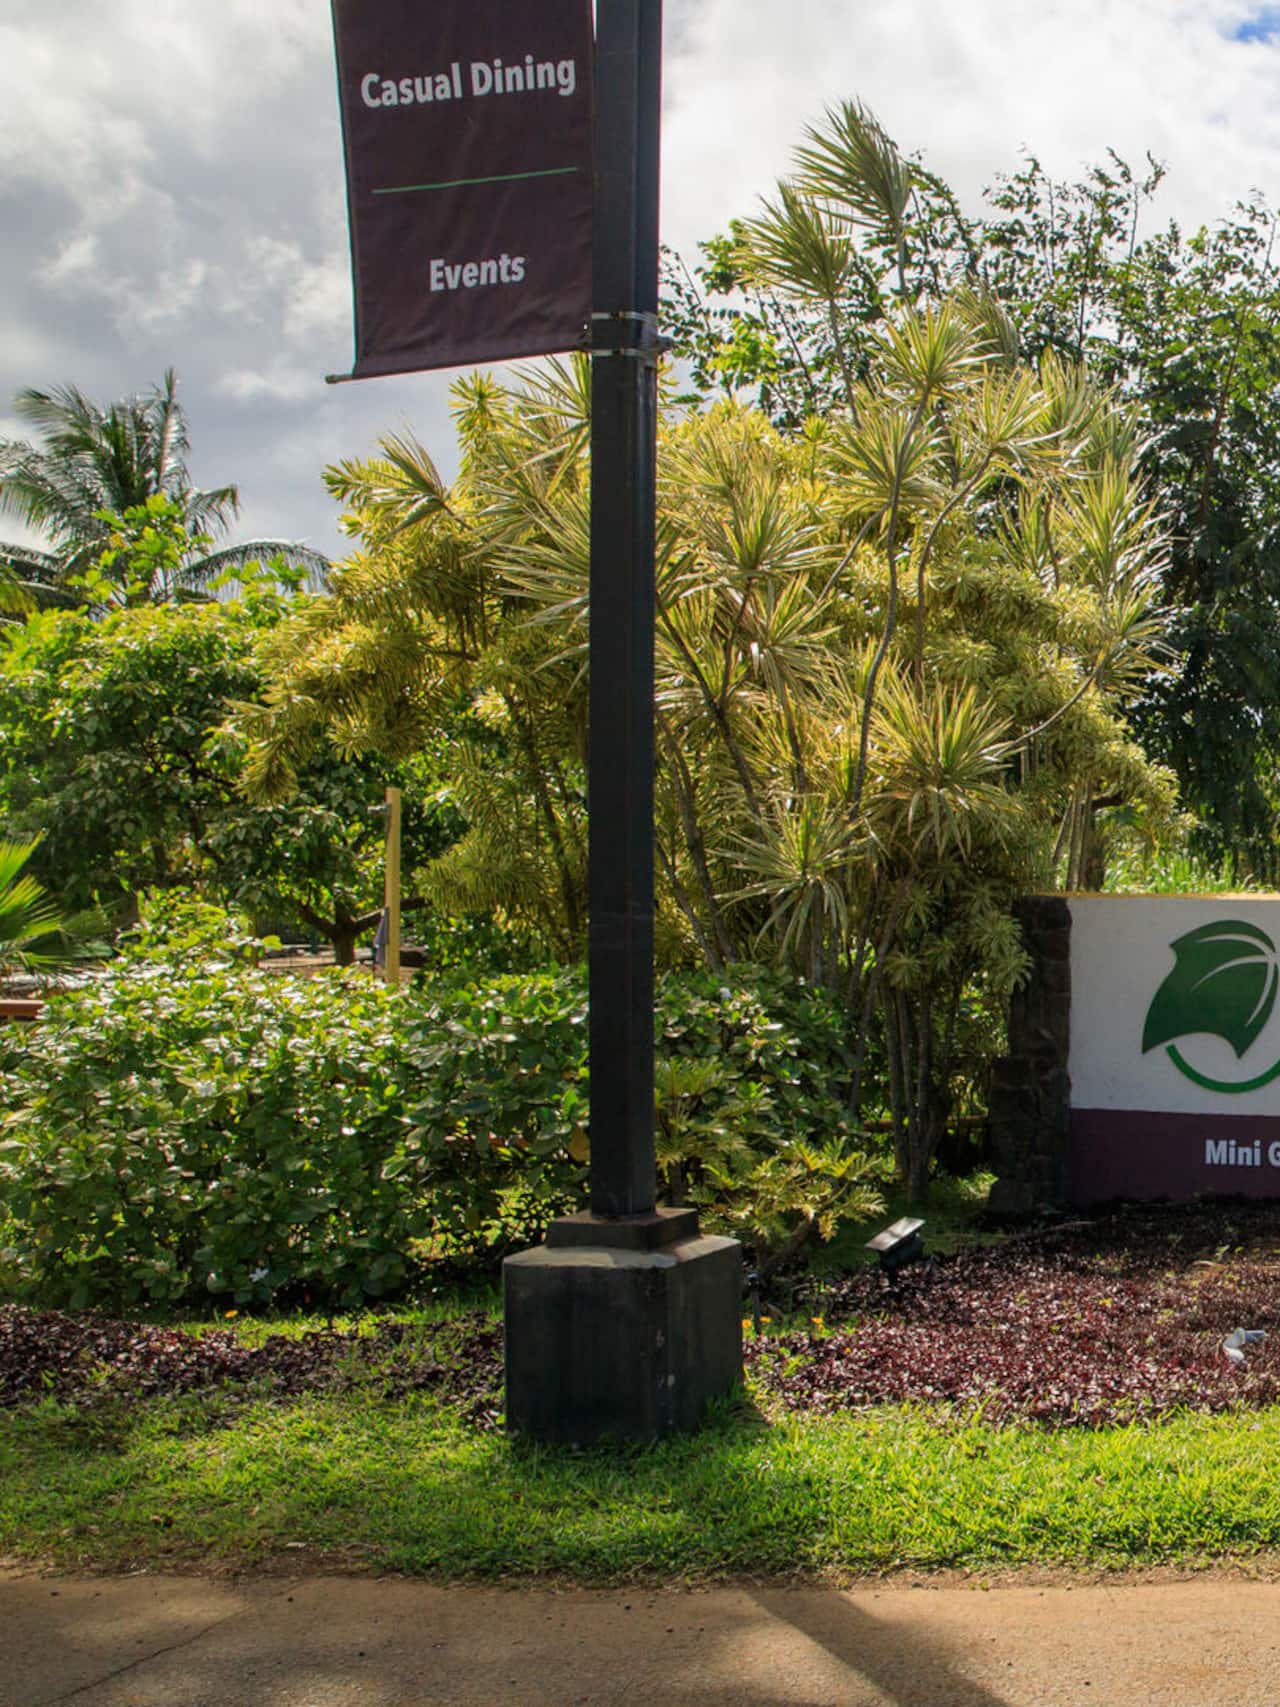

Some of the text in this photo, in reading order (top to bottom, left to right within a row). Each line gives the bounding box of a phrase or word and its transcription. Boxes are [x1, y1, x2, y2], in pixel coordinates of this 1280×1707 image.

[360, 54, 576, 108] Casual Dining
[429, 253, 526, 292] Events
[1205, 1139, 1262, 1167] Mini
